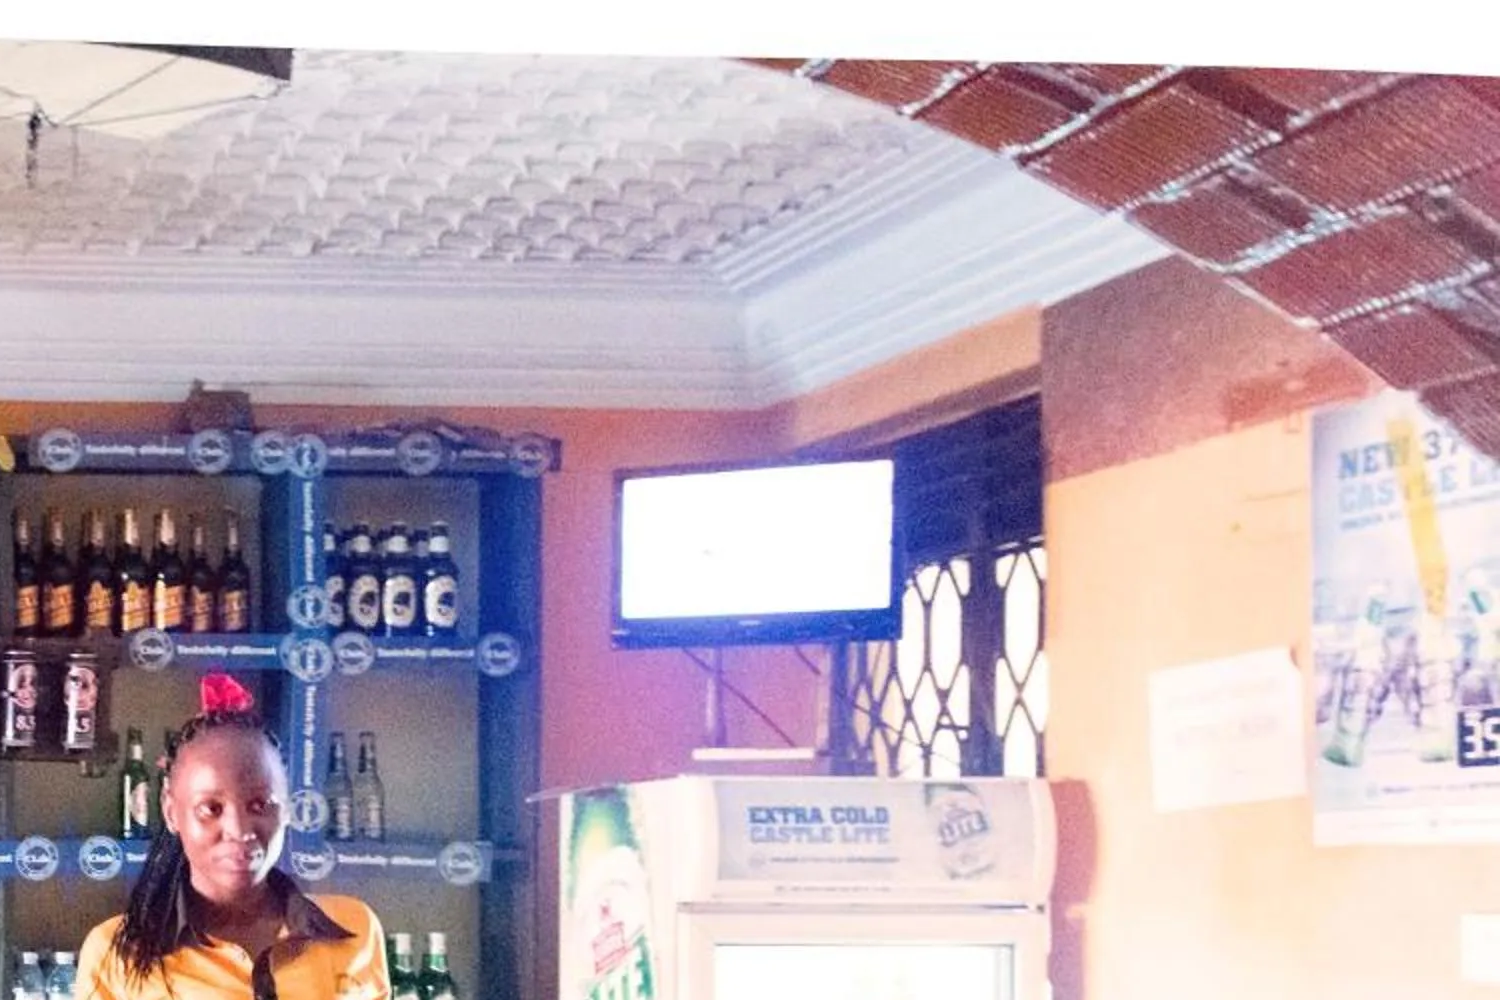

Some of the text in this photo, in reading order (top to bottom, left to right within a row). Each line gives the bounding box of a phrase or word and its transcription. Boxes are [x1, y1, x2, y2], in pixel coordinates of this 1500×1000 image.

[747, 806, 890, 825] EXTRA COLD
[749, 826, 890, 844] CASTLE LITE
